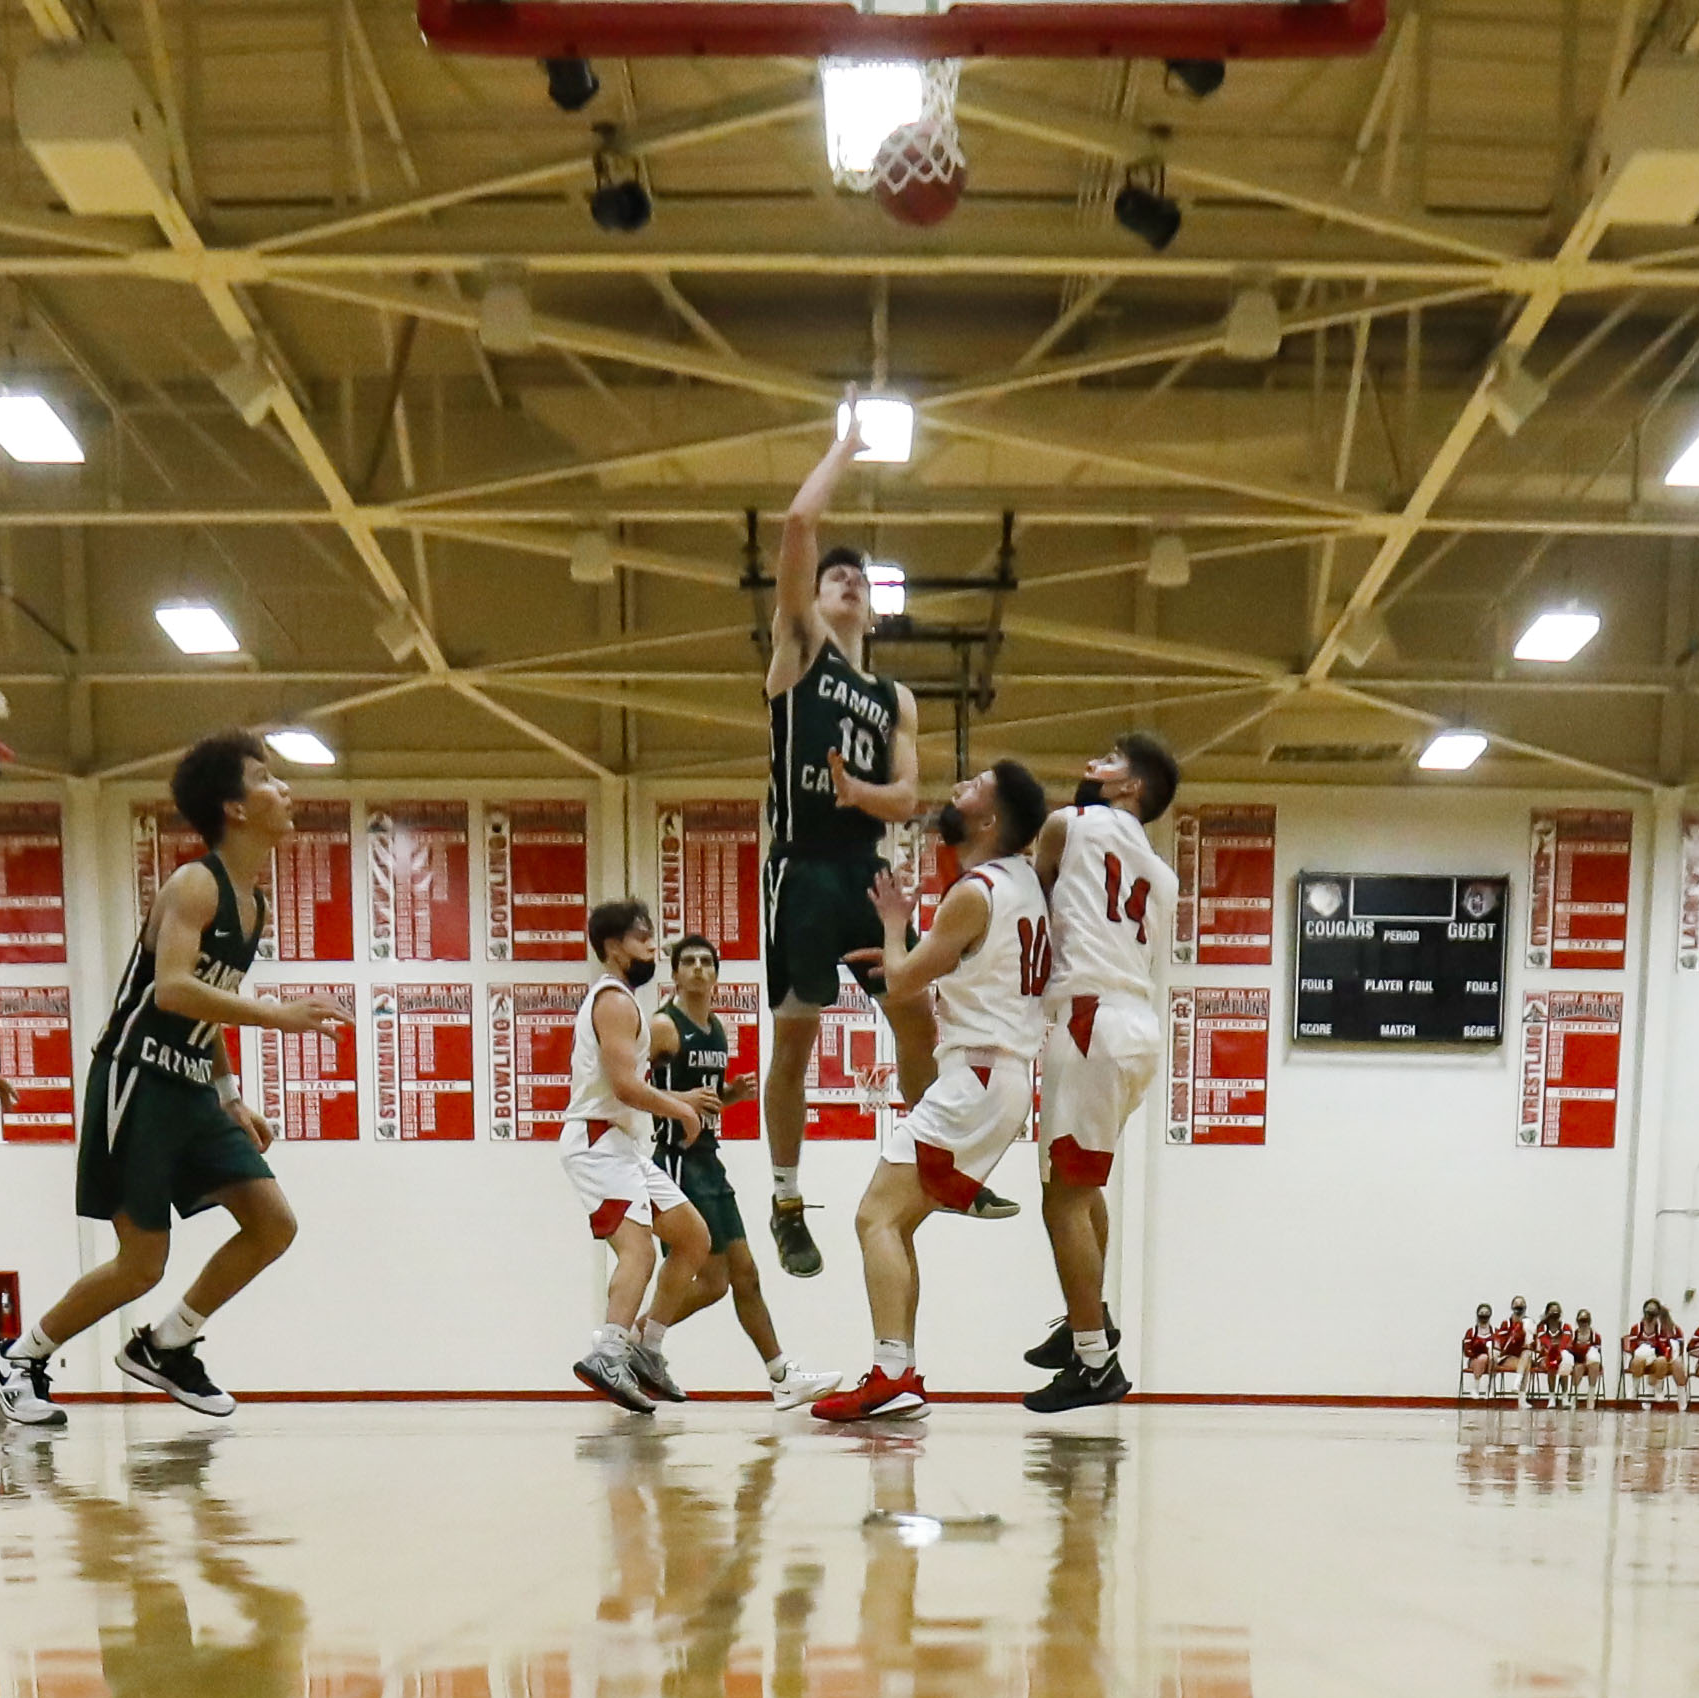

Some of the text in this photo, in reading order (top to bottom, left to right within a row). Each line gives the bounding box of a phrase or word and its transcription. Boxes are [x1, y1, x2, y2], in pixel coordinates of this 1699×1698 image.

[817, 673, 891, 738] CAMDE
[838, 716, 875, 772] 10
[1104, 852, 1151, 945] 14
[1305, 920, 1376, 938] COUGARS
[1447, 922, 1497, 939] GUEST
[528, 931, 569, 941] STATE
[1214, 935, 1255, 944] STATE
[1383, 930, 1421, 943] PERIOD
[1567, 940, 1610, 949] STATE
[1017, 914, 1052, 997] 10
[429, 985, 448, 994] HILL
[451, 985, 470, 994] EAST
[1301, 979, 1334, 991] FOULS
[1364, 979, 1434, 992] PLAYER FOUL
[1465, 981, 1499, 993] FOULS
[399, 995, 471, 1012] CHAMPIONS
[711, 995, 758, 1011] MPIONS
[1197, 999, 1268, 1016] CHAMPIONS
[1551, 1002, 1621, 1019] CHAMPIONS
[407, 1015, 462, 1023] SECTIONAL
[1199, 1020, 1264, 1029] CONFERENCE
[1300, 1024, 1333, 1035] SCORE
[1380, 1025, 1417, 1036] MATCH
[1463, 1026, 1497, 1037] SCORE
[1552, 1023, 1615, 1031] CONFERENCE
[376, 1019, 396, 1119] SWIMMING
[492, 1018, 512, 1118] BOWLING
[261, 1031, 281, 1120] SWIMMIN
[1522, 1025, 1543, 1125] WRESTLING
[300, 1081, 341, 1090] STATE
[415, 1081, 456, 1090] STATE
[1202, 1080, 1256, 1088] SECTIONAL
[1558, 1089, 1603, 1097] DISTRICT
[17, 1114, 58, 1123] STATE
[531, 1111, 564, 1120] STAT
[1208, 1116, 1249, 1124] STATE
